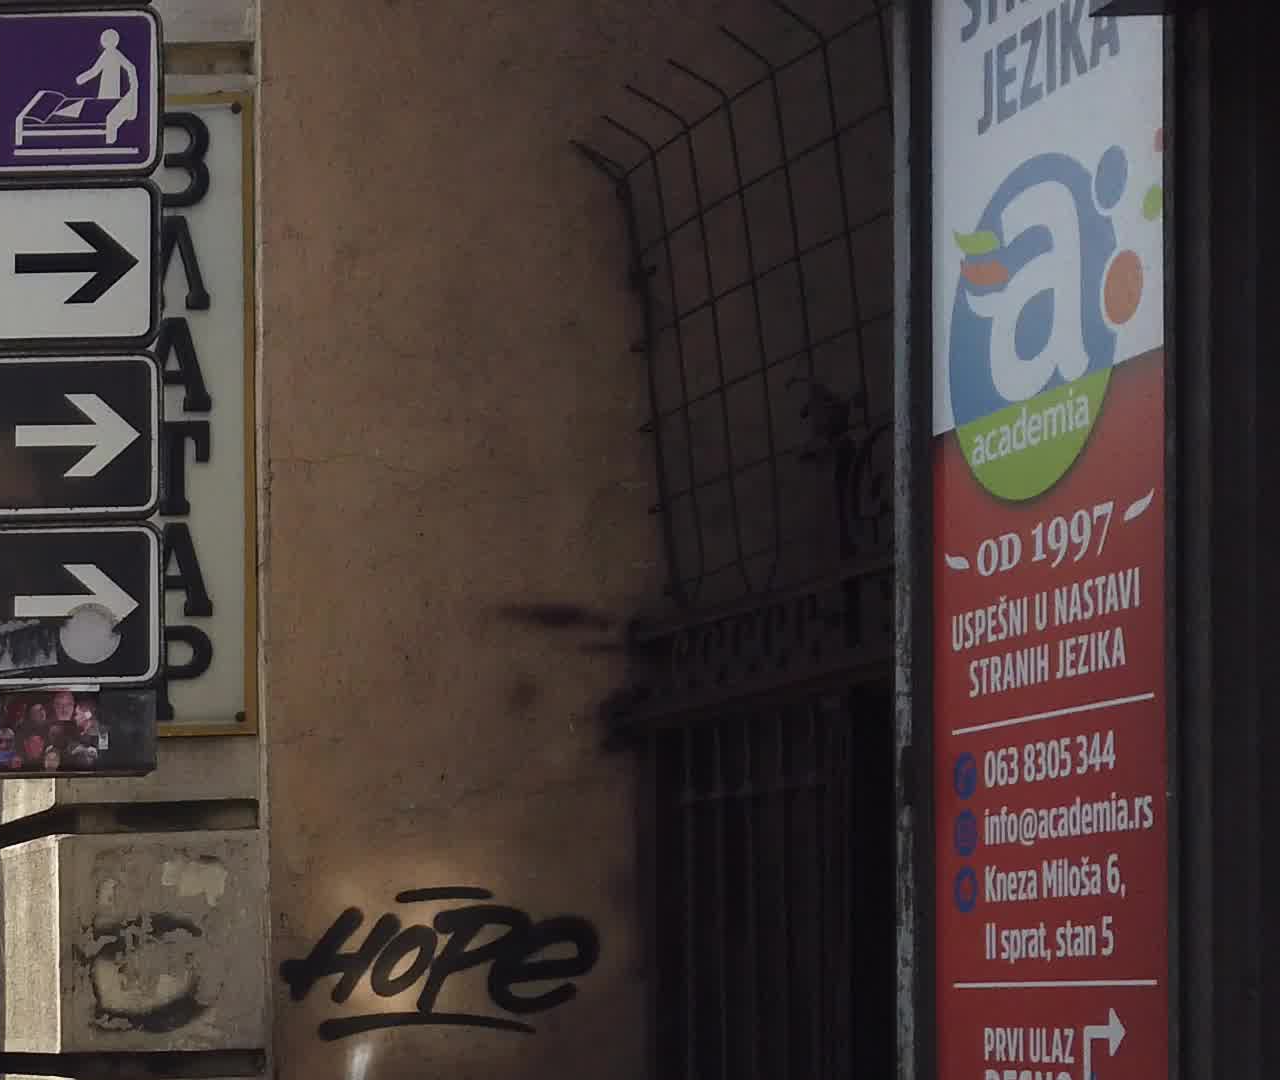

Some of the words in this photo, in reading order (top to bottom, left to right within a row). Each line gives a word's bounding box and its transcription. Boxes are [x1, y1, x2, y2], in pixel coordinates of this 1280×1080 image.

[977, 0, 1121, 136] JEZIKA
[969, 388, 1090, 467] academia
[977, 532, 1021, 576] OD
[1031, 501, 1115, 568] 1997
[951, 596, 1028, 652] USPEŠNI
[1035, 591, 1048, 631] U
[1055, 567, 1141, 625] NASTAVI
[969, 644, 1049, 698] STRANIH
[1056, 626, 1126, 680] JEZIKA
[984, 745, 1019, 789] 063
[1024, 737, 1071, 782] 8305
[1076, 730, 1115, 775] 344
[984, 792, 1153, 846] info@academia.rs
[985, 865, 1037, 903] Kneza
[1042, 855, 1101, 899] Miloša
[1107, 854, 1126, 898] 6,
[1001, 922, 1051, 964] sprat,
[1056, 921, 1096, 958] stan
[1101, 916, 1114, 957] 5
[984, 1027, 1024, 1062] PRVI
[1029, 1028, 1075, 1064] ULAZ
